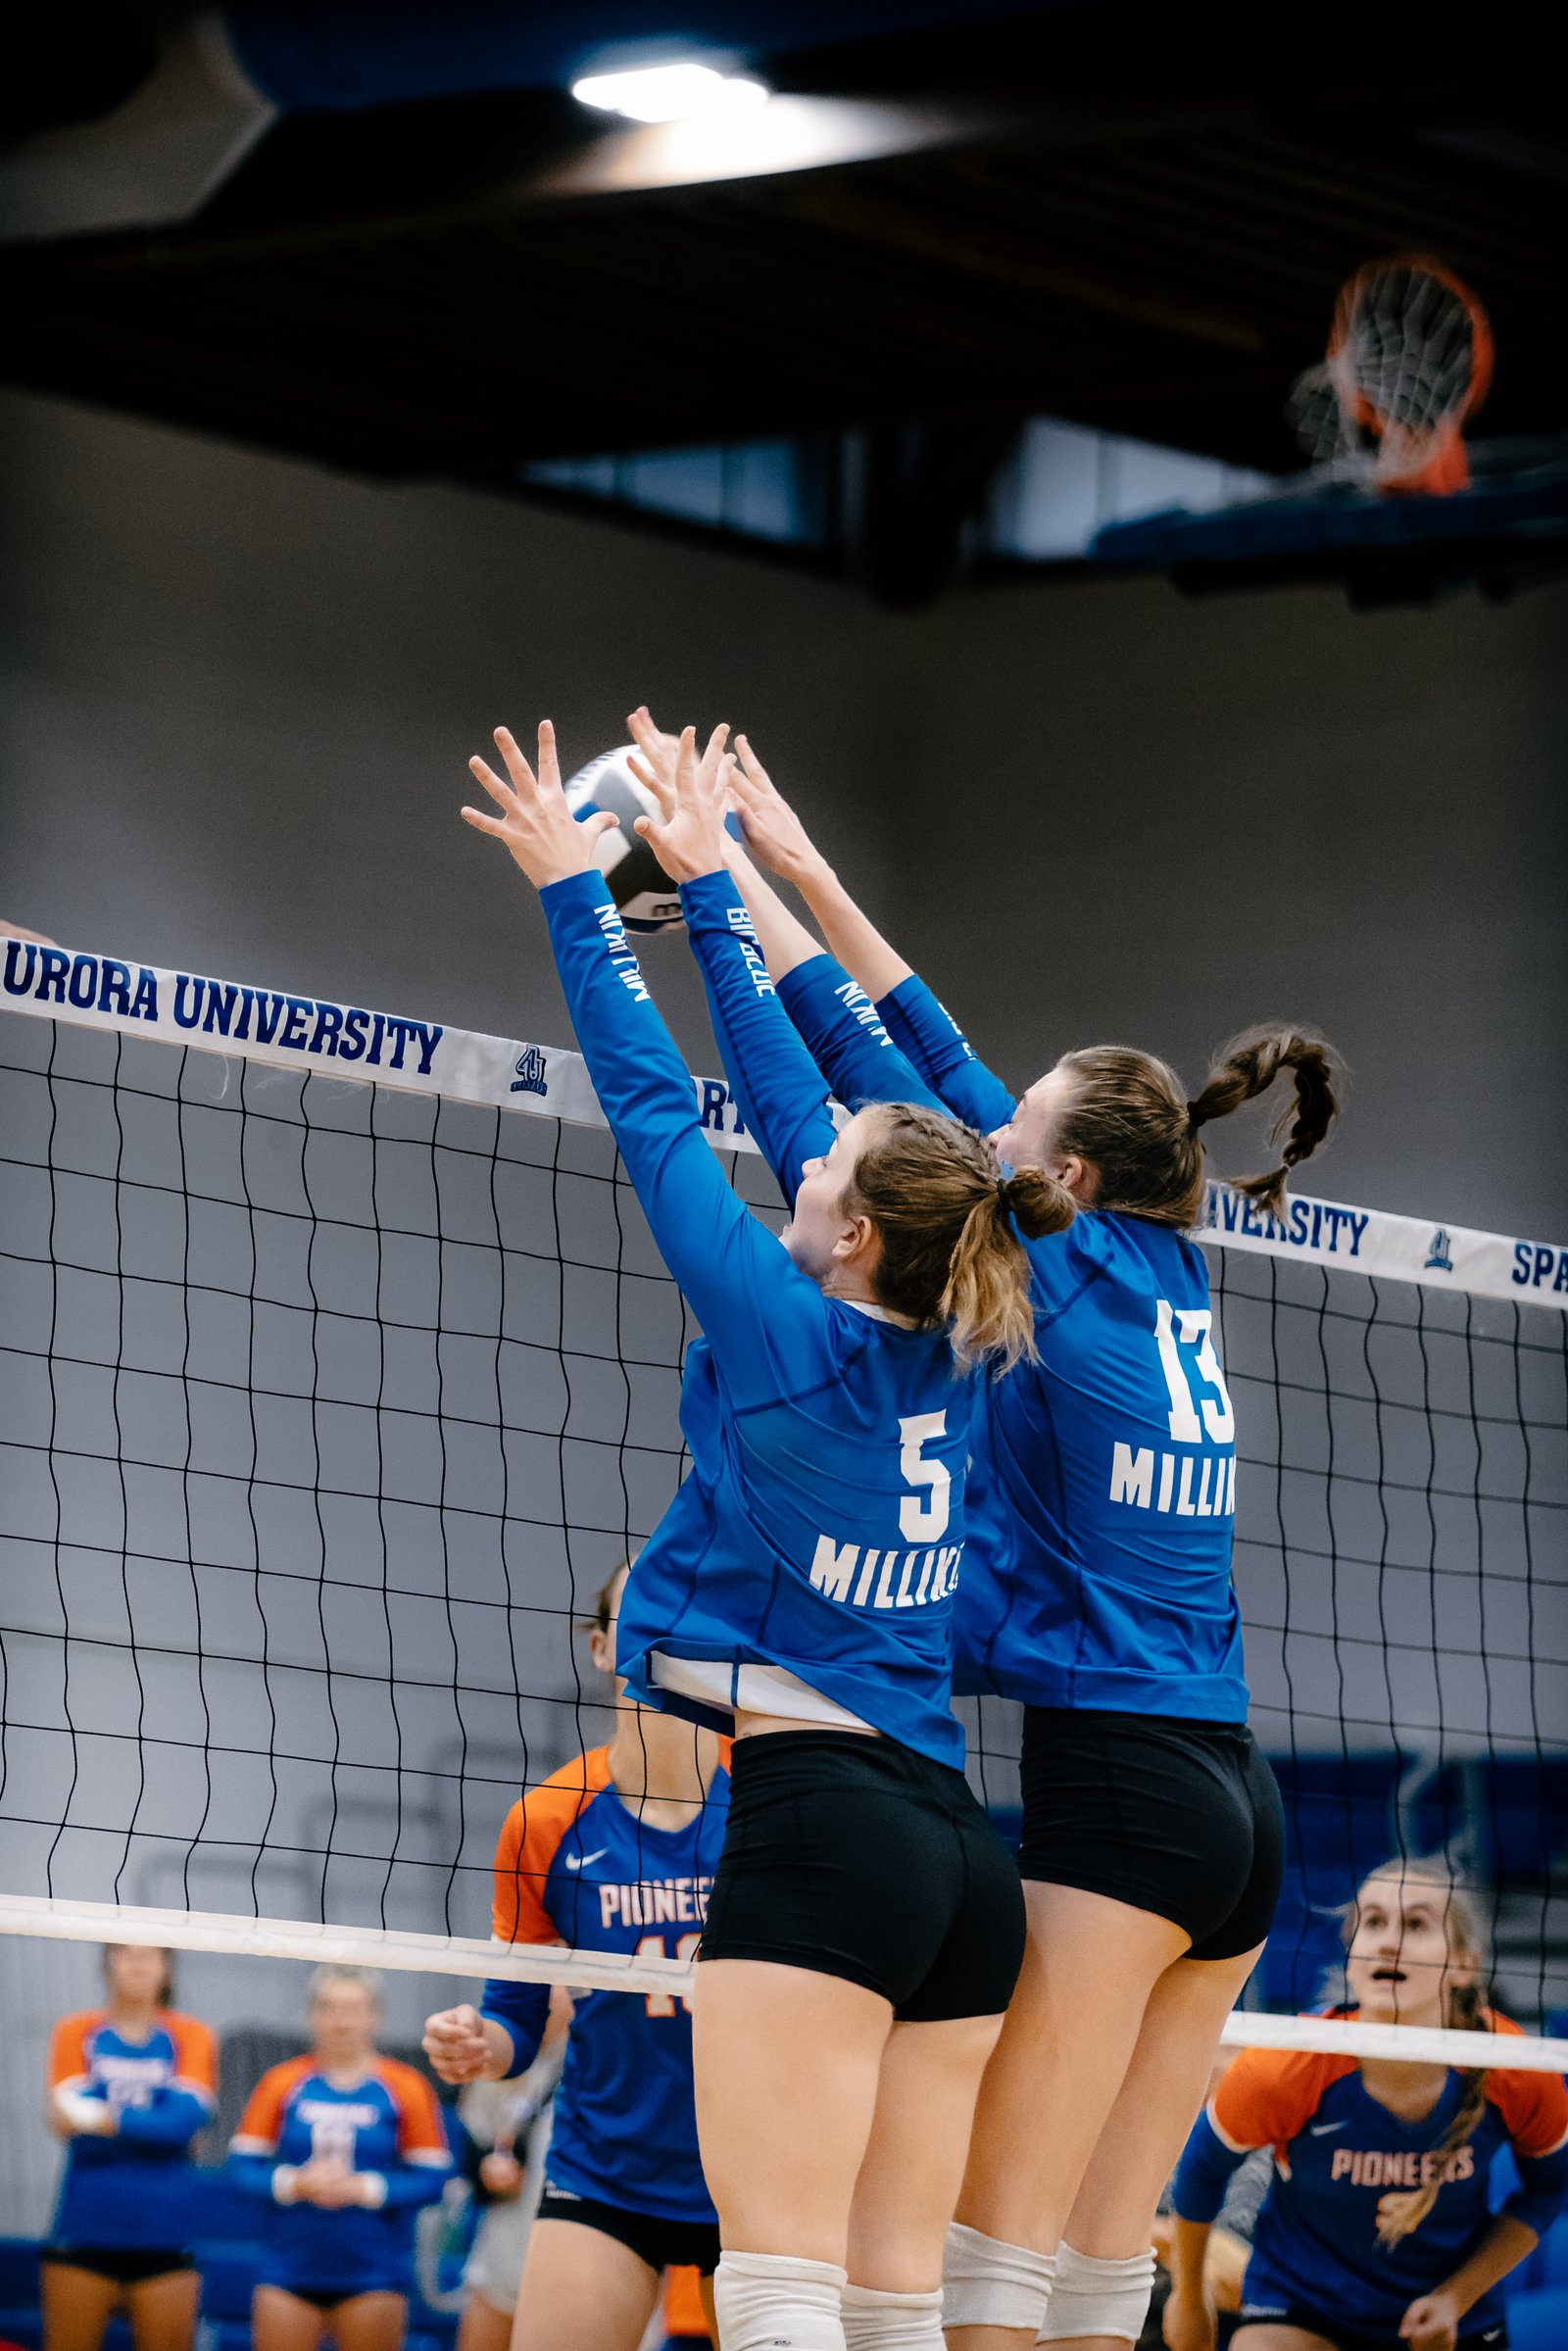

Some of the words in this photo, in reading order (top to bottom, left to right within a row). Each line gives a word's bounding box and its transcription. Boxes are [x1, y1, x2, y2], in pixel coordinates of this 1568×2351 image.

[4, 940, 159, 1022] URORA
[173, 974, 443, 1075] UNIVERSITY
[1153, 1299, 1235, 1444] 13
[898, 1408, 952, 1543] 5
[599, 1876, 714, 1929] PIONEE
